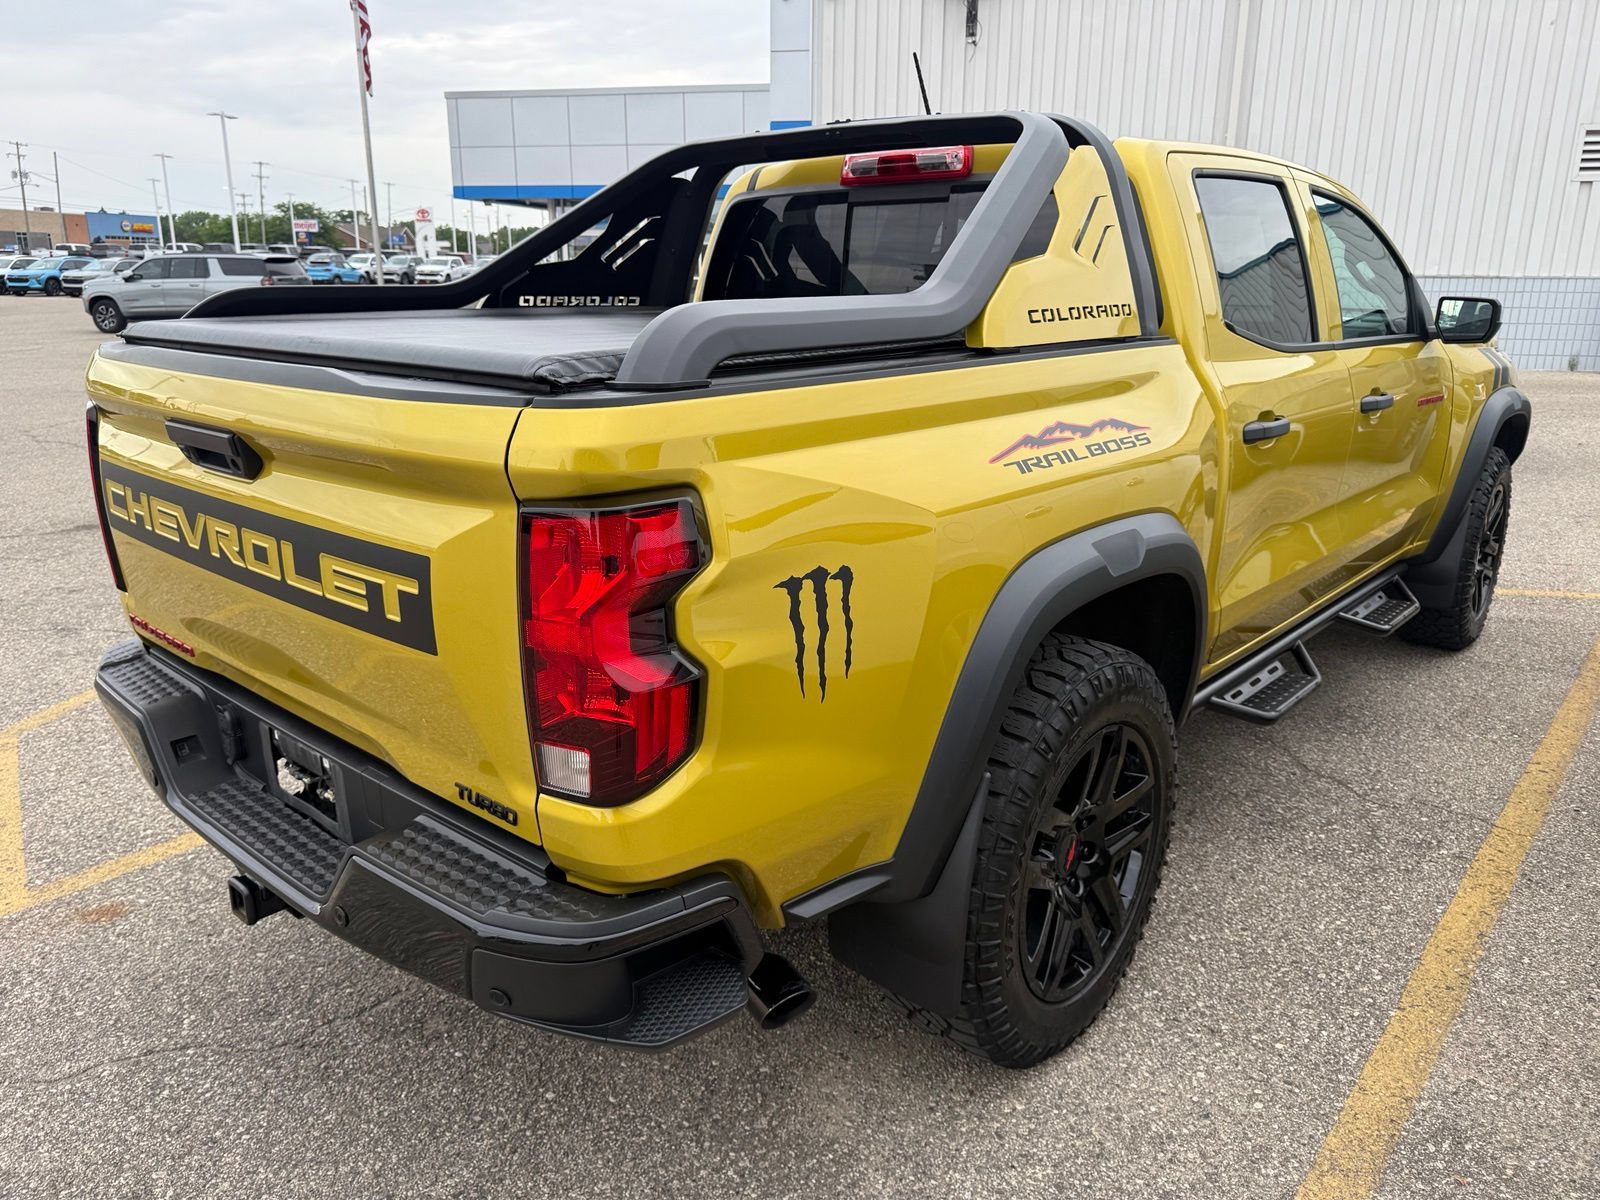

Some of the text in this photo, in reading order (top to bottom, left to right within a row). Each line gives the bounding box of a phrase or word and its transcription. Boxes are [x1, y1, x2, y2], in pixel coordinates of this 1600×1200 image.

[1027, 303, 1132, 324] COLORADO
[105, 478, 419, 622] CHEVROLET
[454, 781, 518, 827] TURBO
